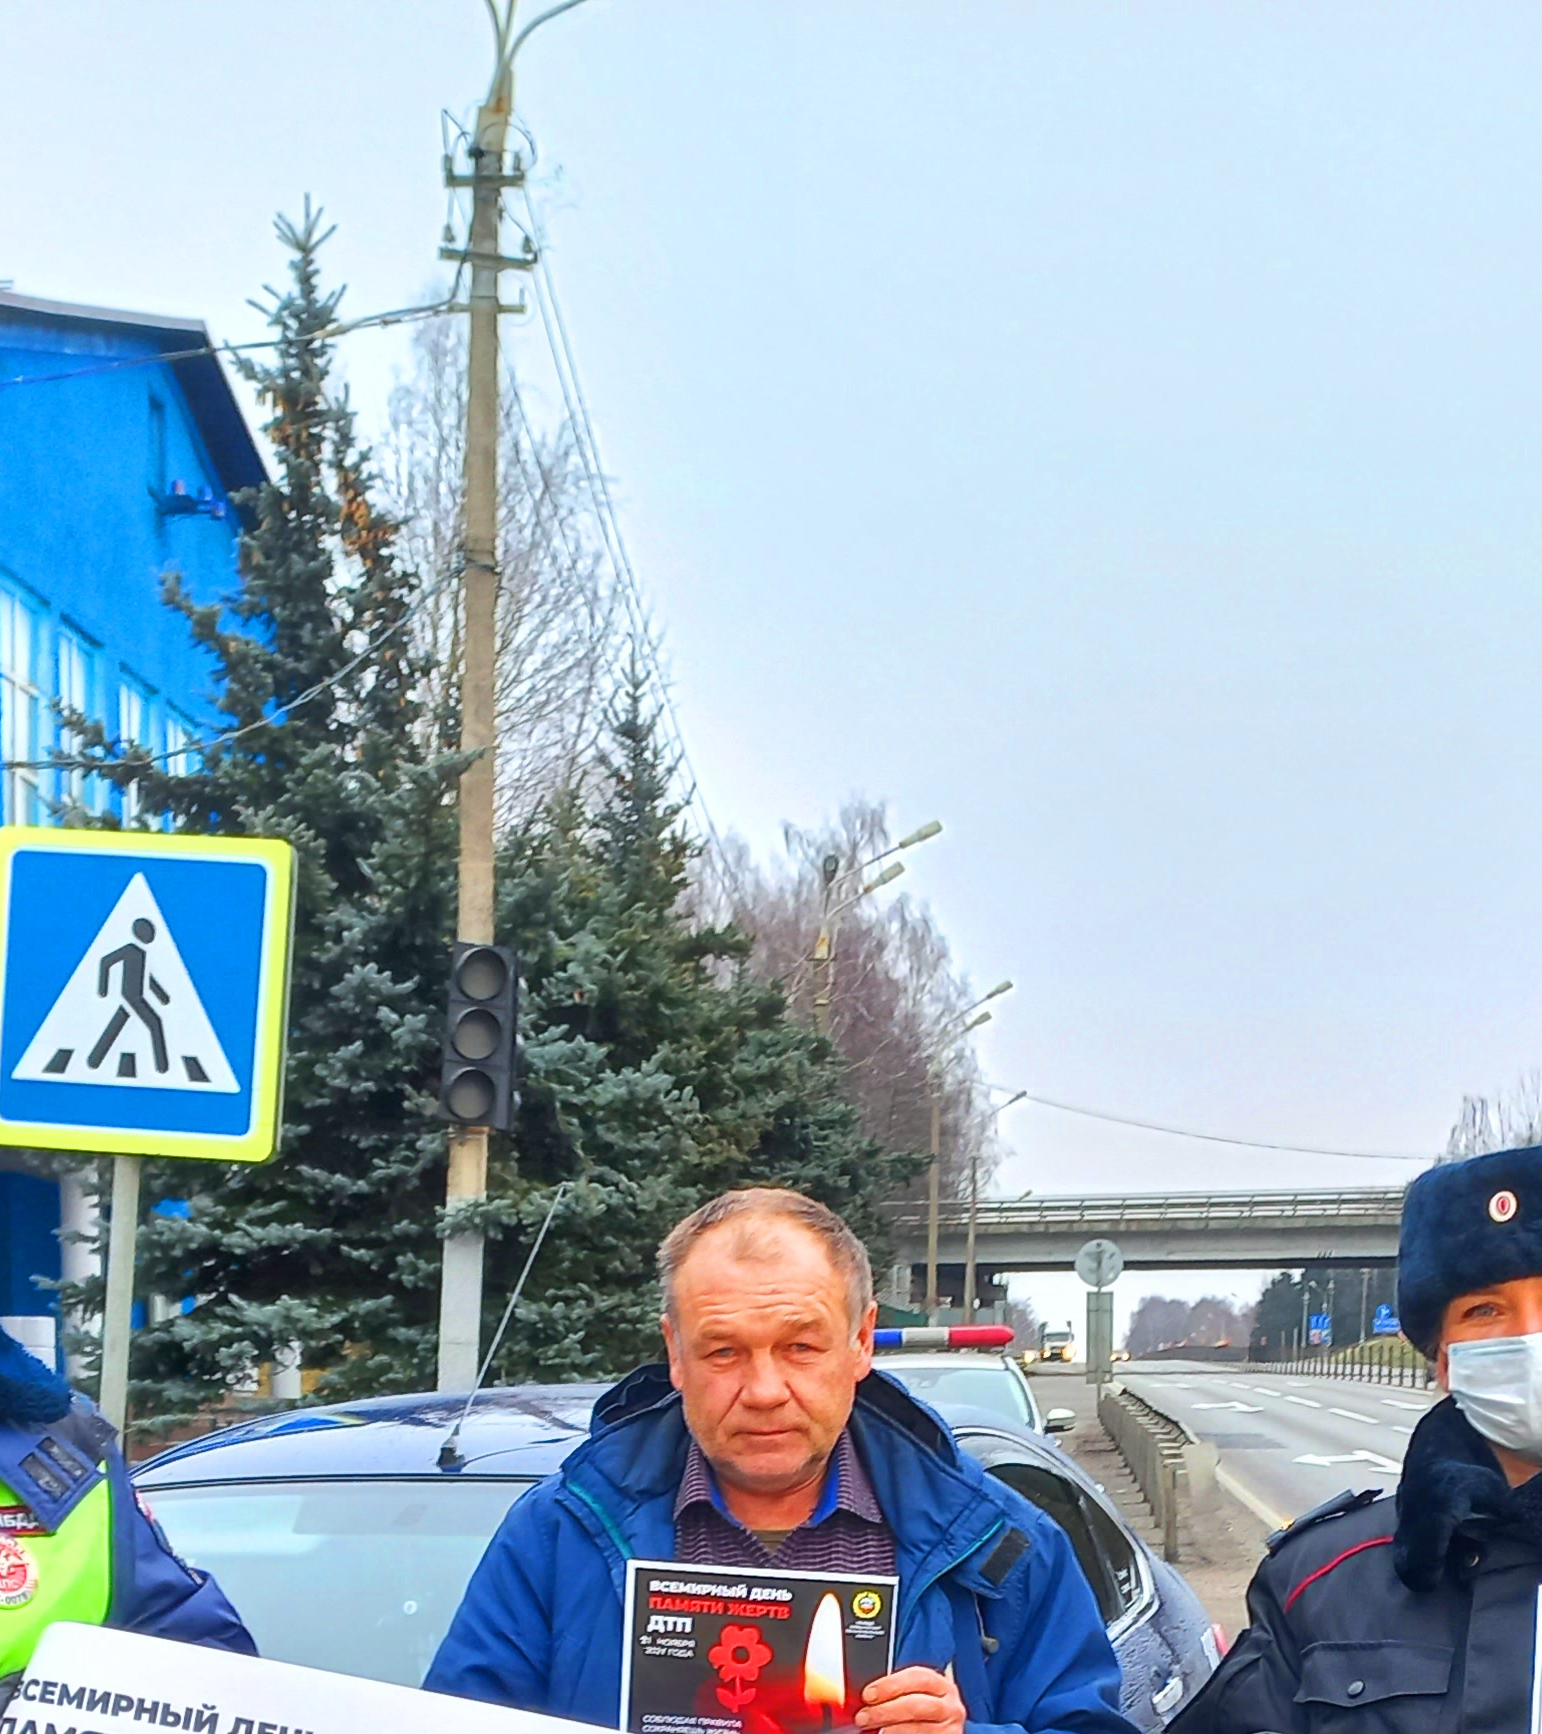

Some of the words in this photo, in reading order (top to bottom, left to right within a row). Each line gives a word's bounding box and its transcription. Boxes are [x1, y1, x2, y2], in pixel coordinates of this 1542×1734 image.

[649, 1580, 748, 1599] ВСЕМИРНЫЙ
[749, 1587, 793, 1602] ДЕНЬ
[648, 1597, 724, 1615] ПАМЯТИ
[727, 1602, 791, 1619] ЖЕРТВ
[646, 1615, 693, 1634] ДТП
